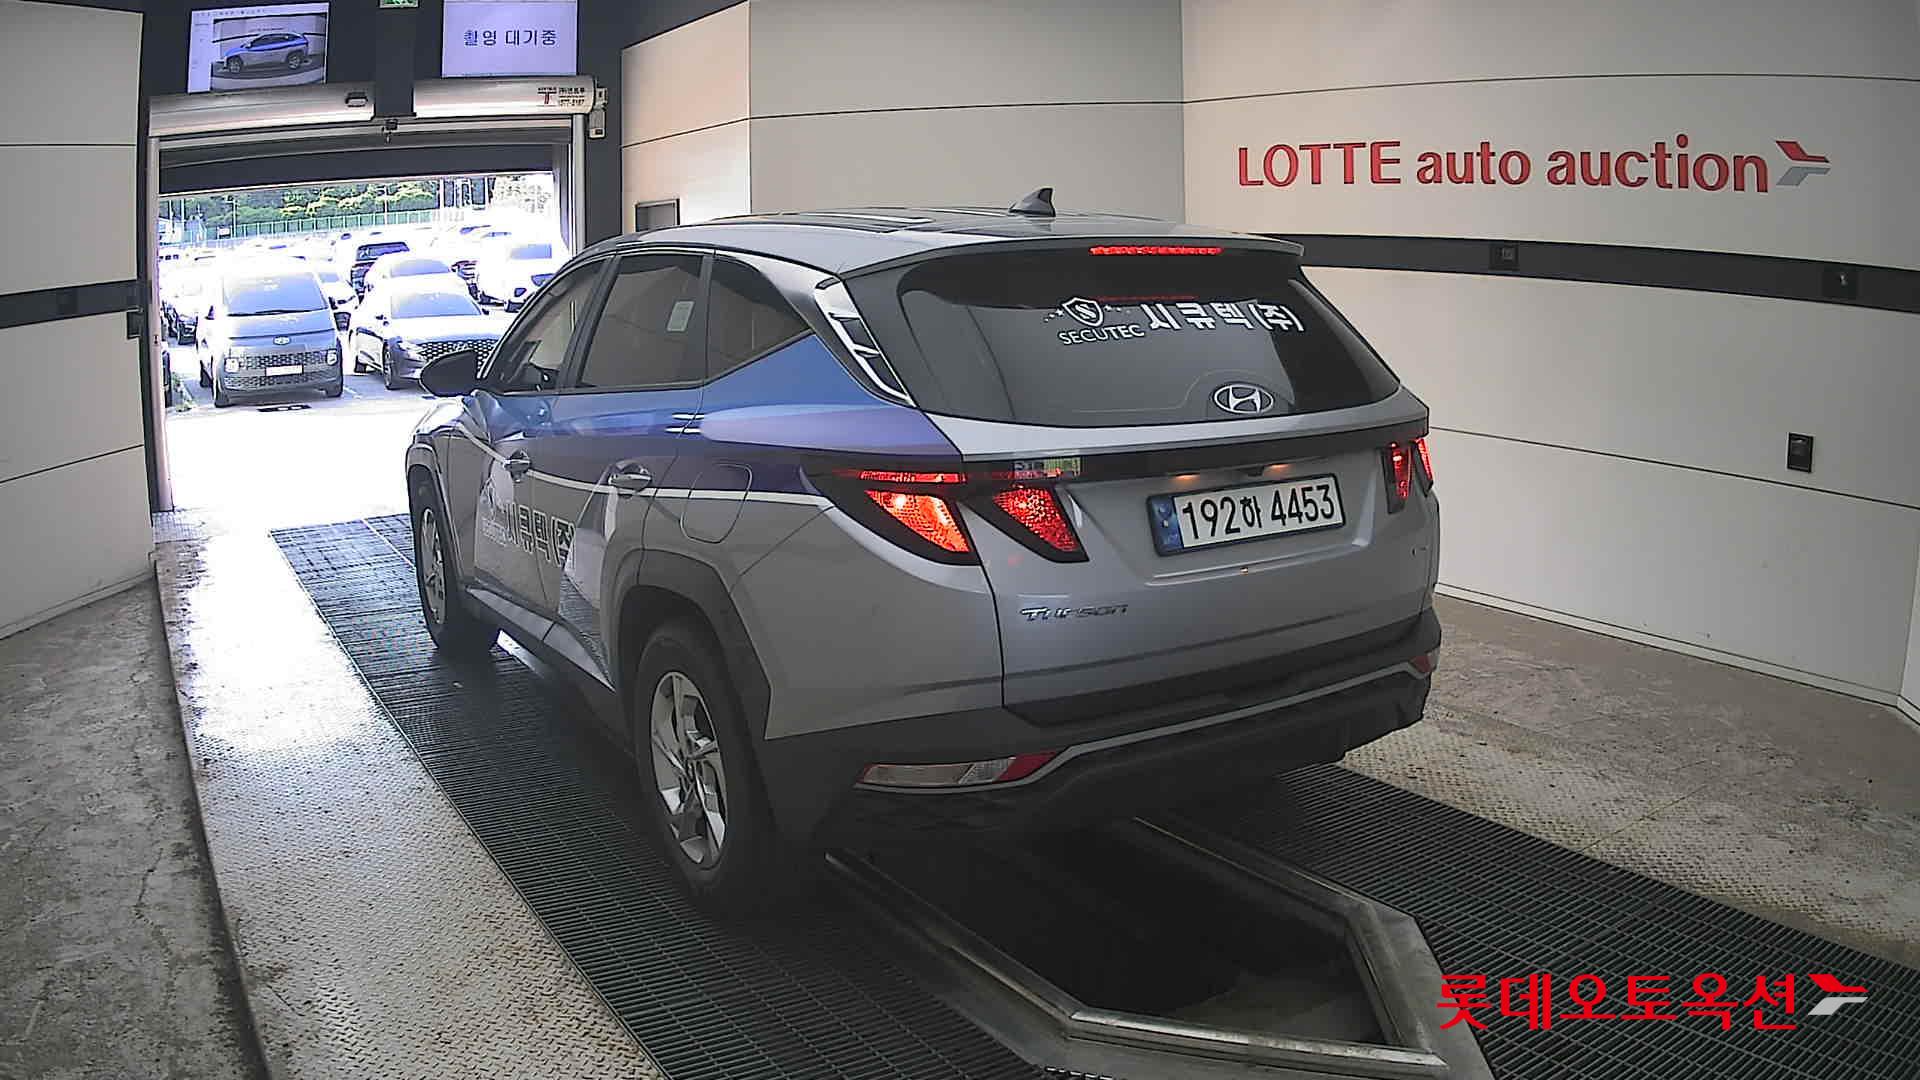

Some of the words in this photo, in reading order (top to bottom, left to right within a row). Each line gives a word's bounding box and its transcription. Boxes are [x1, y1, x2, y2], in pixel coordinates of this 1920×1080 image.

[505, 29, 557, 46] 대기중
[1238, 140, 1401, 187] LOTTE
[1416, 141, 1532, 185] auto
[1547, 133, 1769, 193] auction
[1140, 301, 1305, 332] 시큐텍(주)
[1058, 324, 1146, 346] SECUTEC
[1182, 495, 1263, 540] 192하
[1271, 483, 1335, 527] 4453
